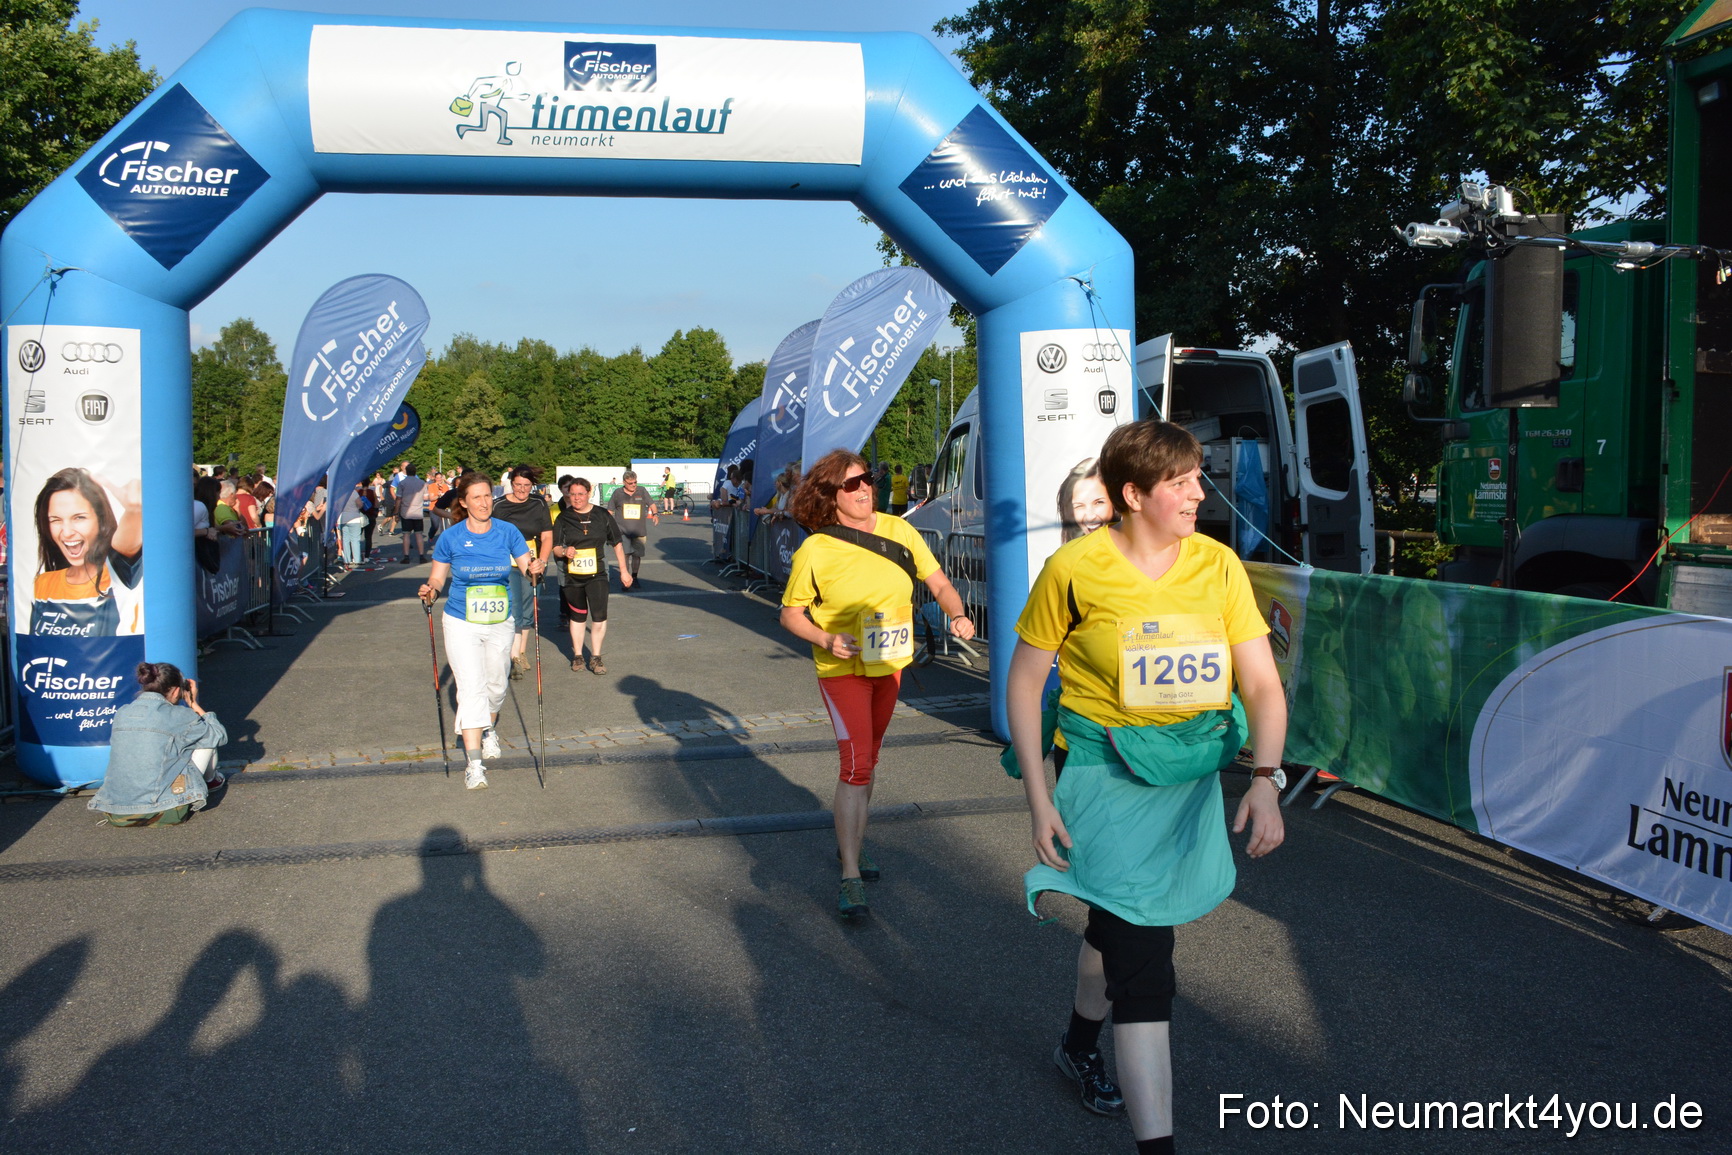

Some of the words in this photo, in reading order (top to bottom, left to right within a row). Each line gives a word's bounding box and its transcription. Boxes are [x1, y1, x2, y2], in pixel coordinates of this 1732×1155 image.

[584, 60, 652, 74] Fischer
[531, 93, 735, 134] firmenlauf
[531, 133, 615, 147] neumarkt
[120, 160, 239, 184] Fischer
[939, 173, 967, 188] und
[999, 170, 1048, 184] Lächeln
[130, 184, 229, 197] AUTOMOBILE
[1018, 187, 1047, 199] mit!
[841, 289, 919, 399] Fischer
[320, 300, 399, 404] Fischer
[868, 308, 928, 397] AUTOMOBILE
[345, 321, 408, 403] AUTOMOBILE
[63, 367, 90, 375] Audi
[84, 400, 107, 416] FIAT
[1100, 394, 1115, 410] FIAT
[18, 417, 54, 426] SEAT
[1037, 413, 1076, 422] SEAT
[1524, 430, 1541, 438] TGM
[1541, 428, 1572, 438] 26.340
[1596, 439, 1607, 455] 7
[570, 558, 594, 568] 1210
[209, 573, 239, 604] Fischer
[471, 600, 505, 613] 1433
[867, 627, 909, 649] 1279
[1135, 631, 1175, 641] firmenlauf
[1125, 643, 1157, 652] walken
[1132, 652, 1221, 686] 1265
[34, 672, 123, 690] Fischer
[41, 691, 115, 700] AUTOMOBILE
[1159, 692, 1177, 700] Tanja
[55, 709, 74, 719] und
[75, 707, 95, 718] das
[79, 719, 107, 731] fährt
